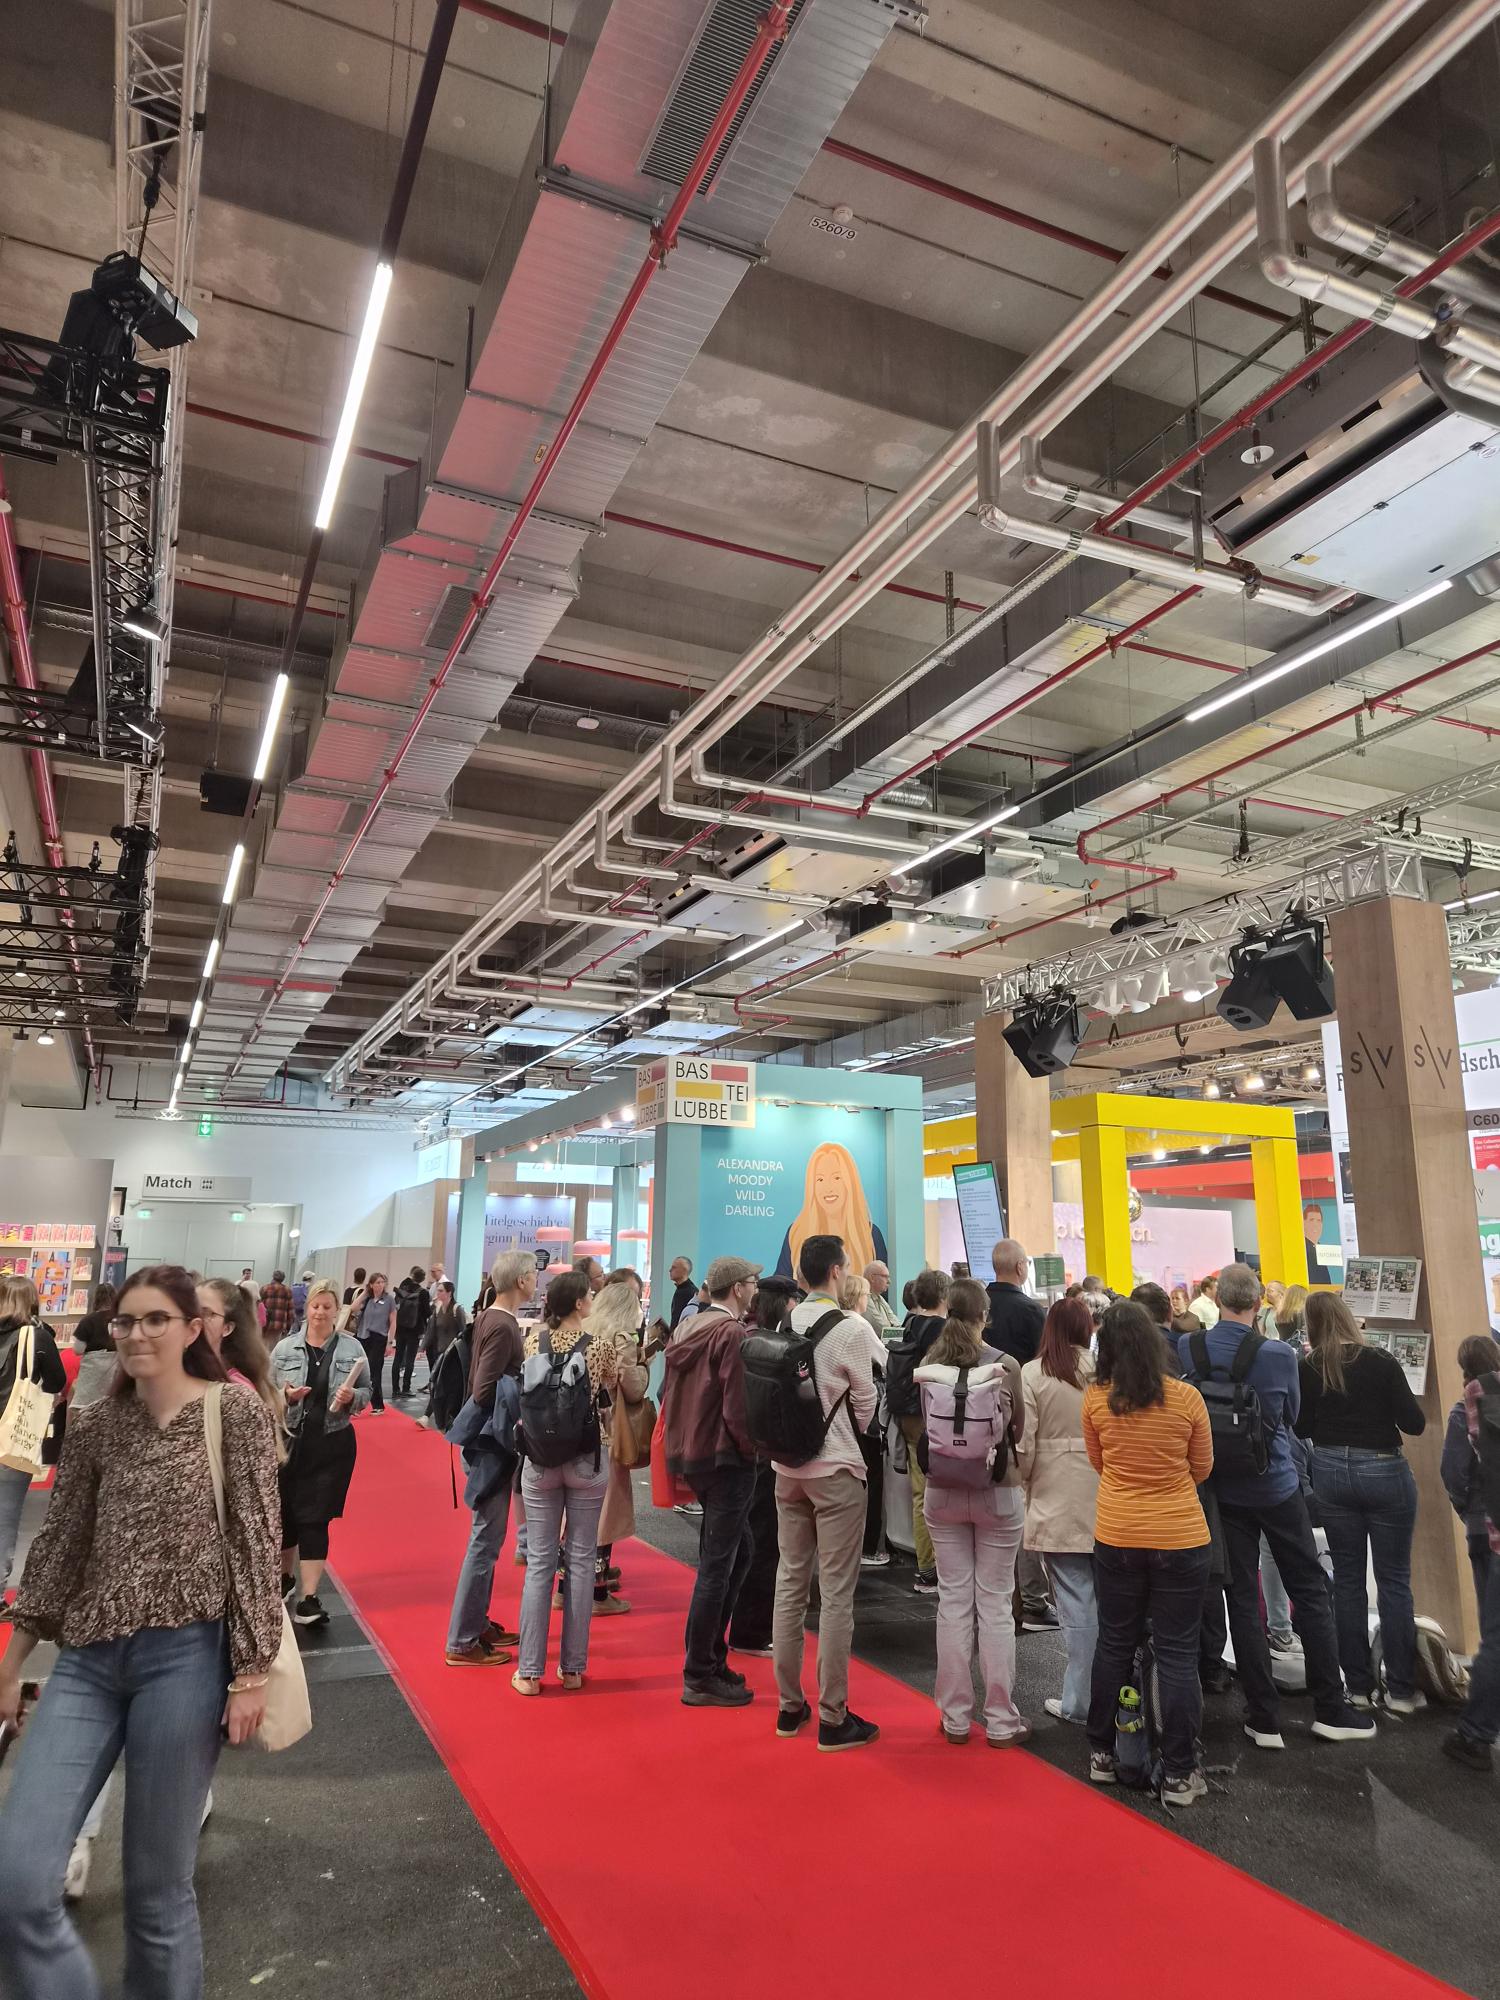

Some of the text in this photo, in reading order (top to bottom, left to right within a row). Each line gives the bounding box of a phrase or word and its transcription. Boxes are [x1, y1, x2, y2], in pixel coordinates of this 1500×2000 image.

[811, 218, 856, 239] 5260/9
[675, 1061, 708, 1080] BAS
[726, 1084, 748, 1102] TEI
[717, 1158, 784, 1172] ALEXANDRA
[146, 1176, 192, 1189] Match
[728, 1173, 773, 1186] MOODY
[735, 1189, 766, 1201] WILD
[725, 1204, 775, 1217] DARLING
